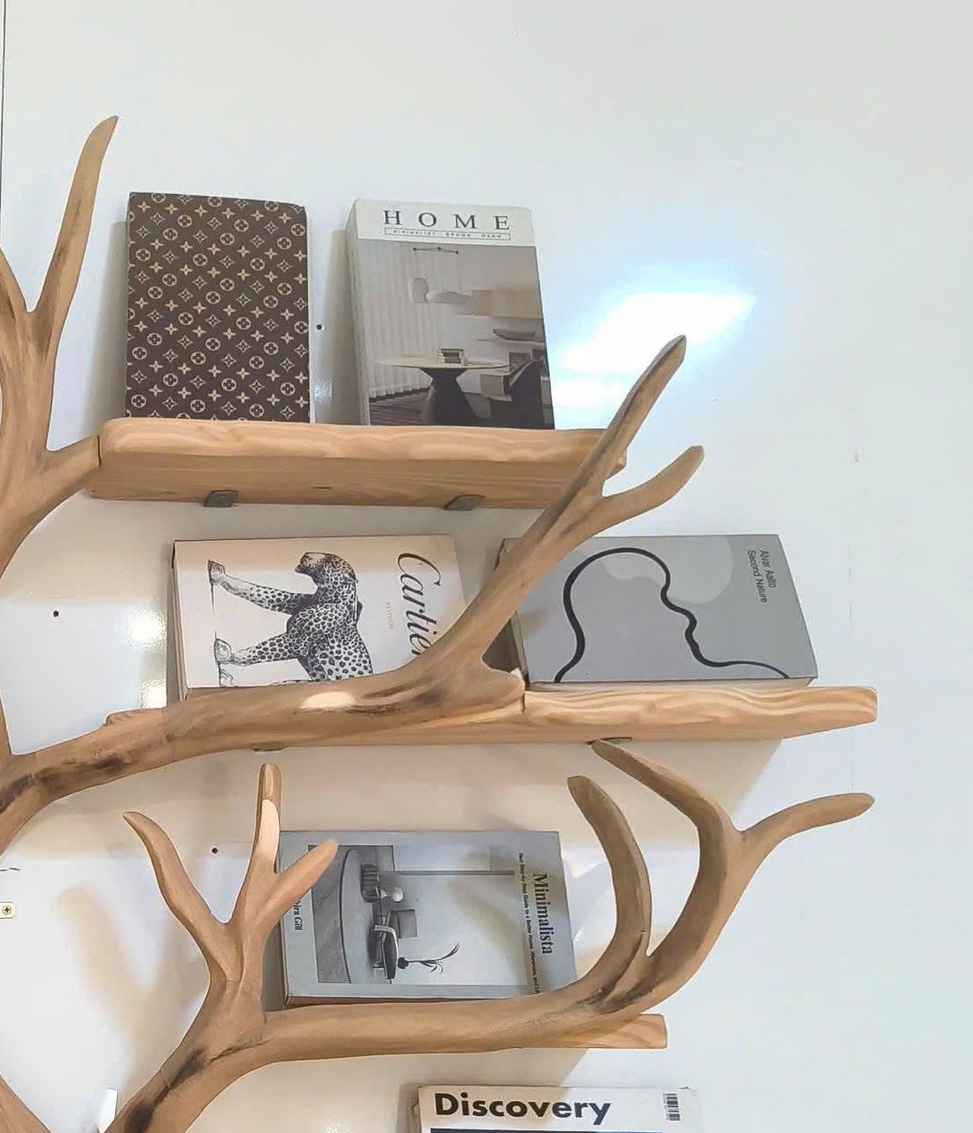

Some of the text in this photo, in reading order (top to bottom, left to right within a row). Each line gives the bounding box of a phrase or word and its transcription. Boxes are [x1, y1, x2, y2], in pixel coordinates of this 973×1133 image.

[383, 209, 511, 231] HOME
[747, 549, 768, 603] Second Nature
[532, 872, 555, 955] Minimalista
[434, 1092, 612, 1125] Discovery
